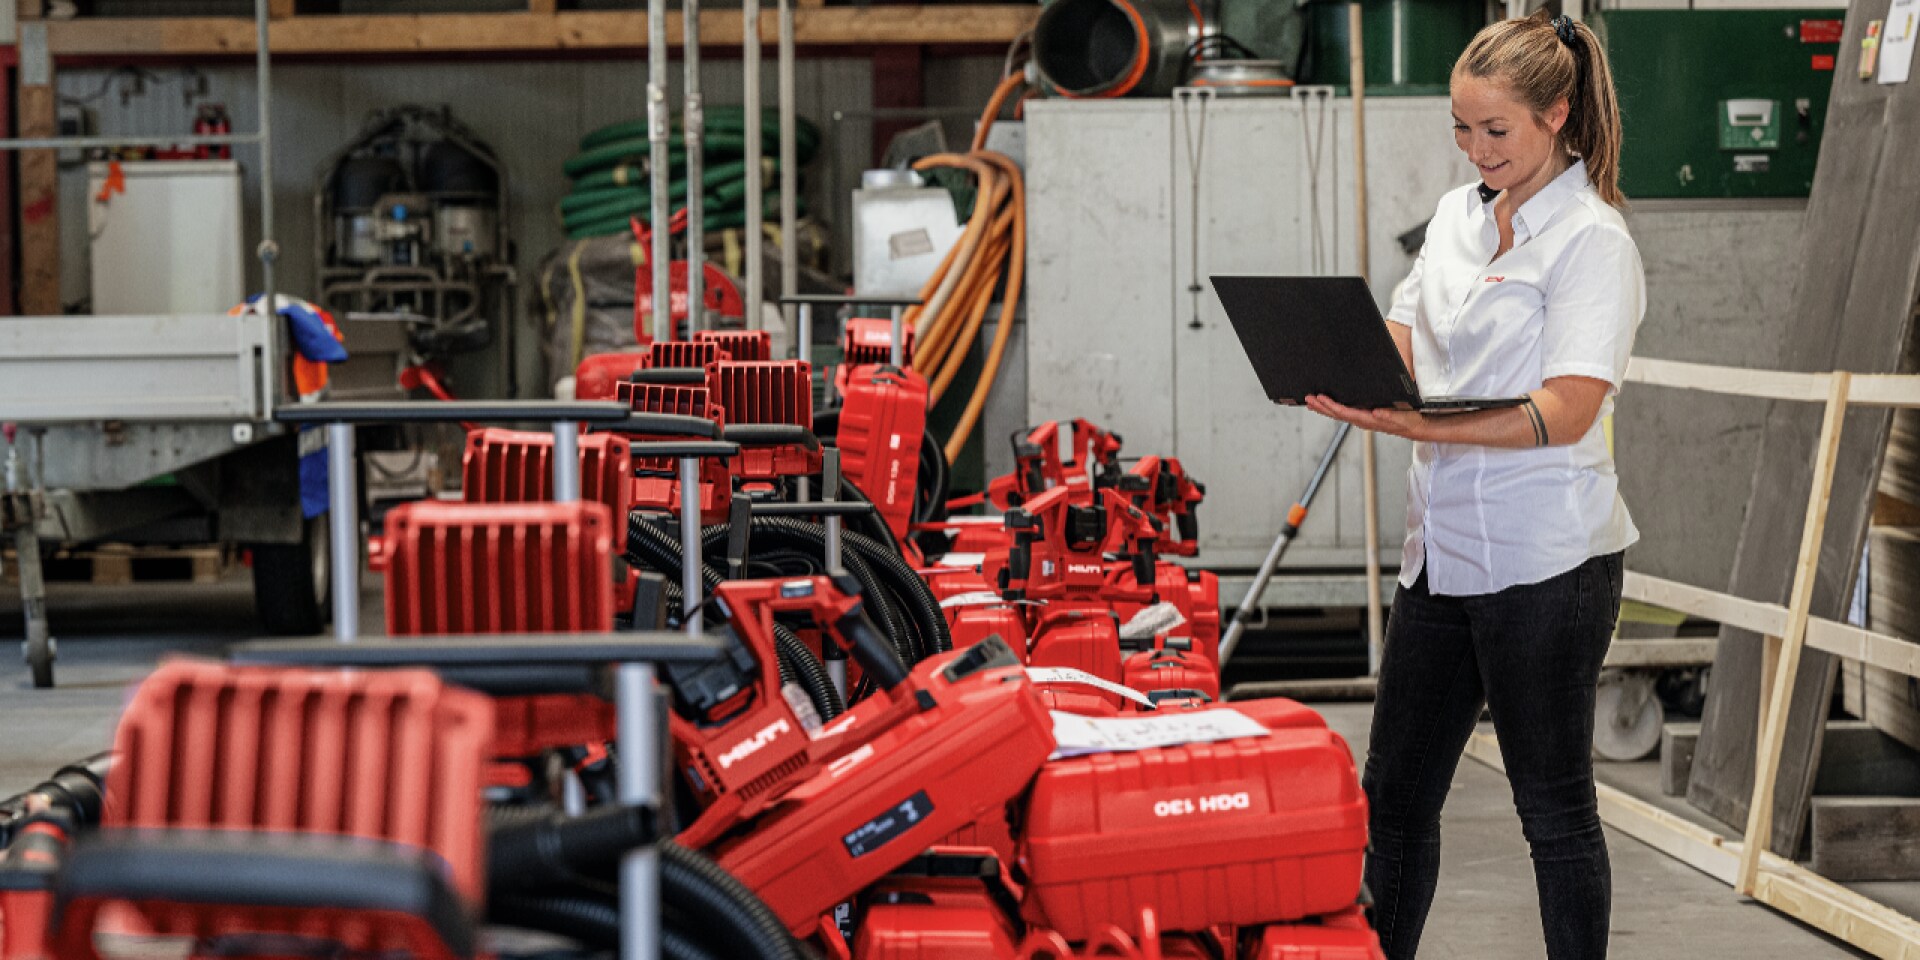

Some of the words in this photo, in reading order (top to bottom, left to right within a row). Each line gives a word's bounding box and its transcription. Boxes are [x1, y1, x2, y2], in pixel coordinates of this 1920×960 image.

[1068, 564, 1101, 574] HILTI
[718, 718, 790, 769] HILTI
[1154, 798, 1196, 817] 130
